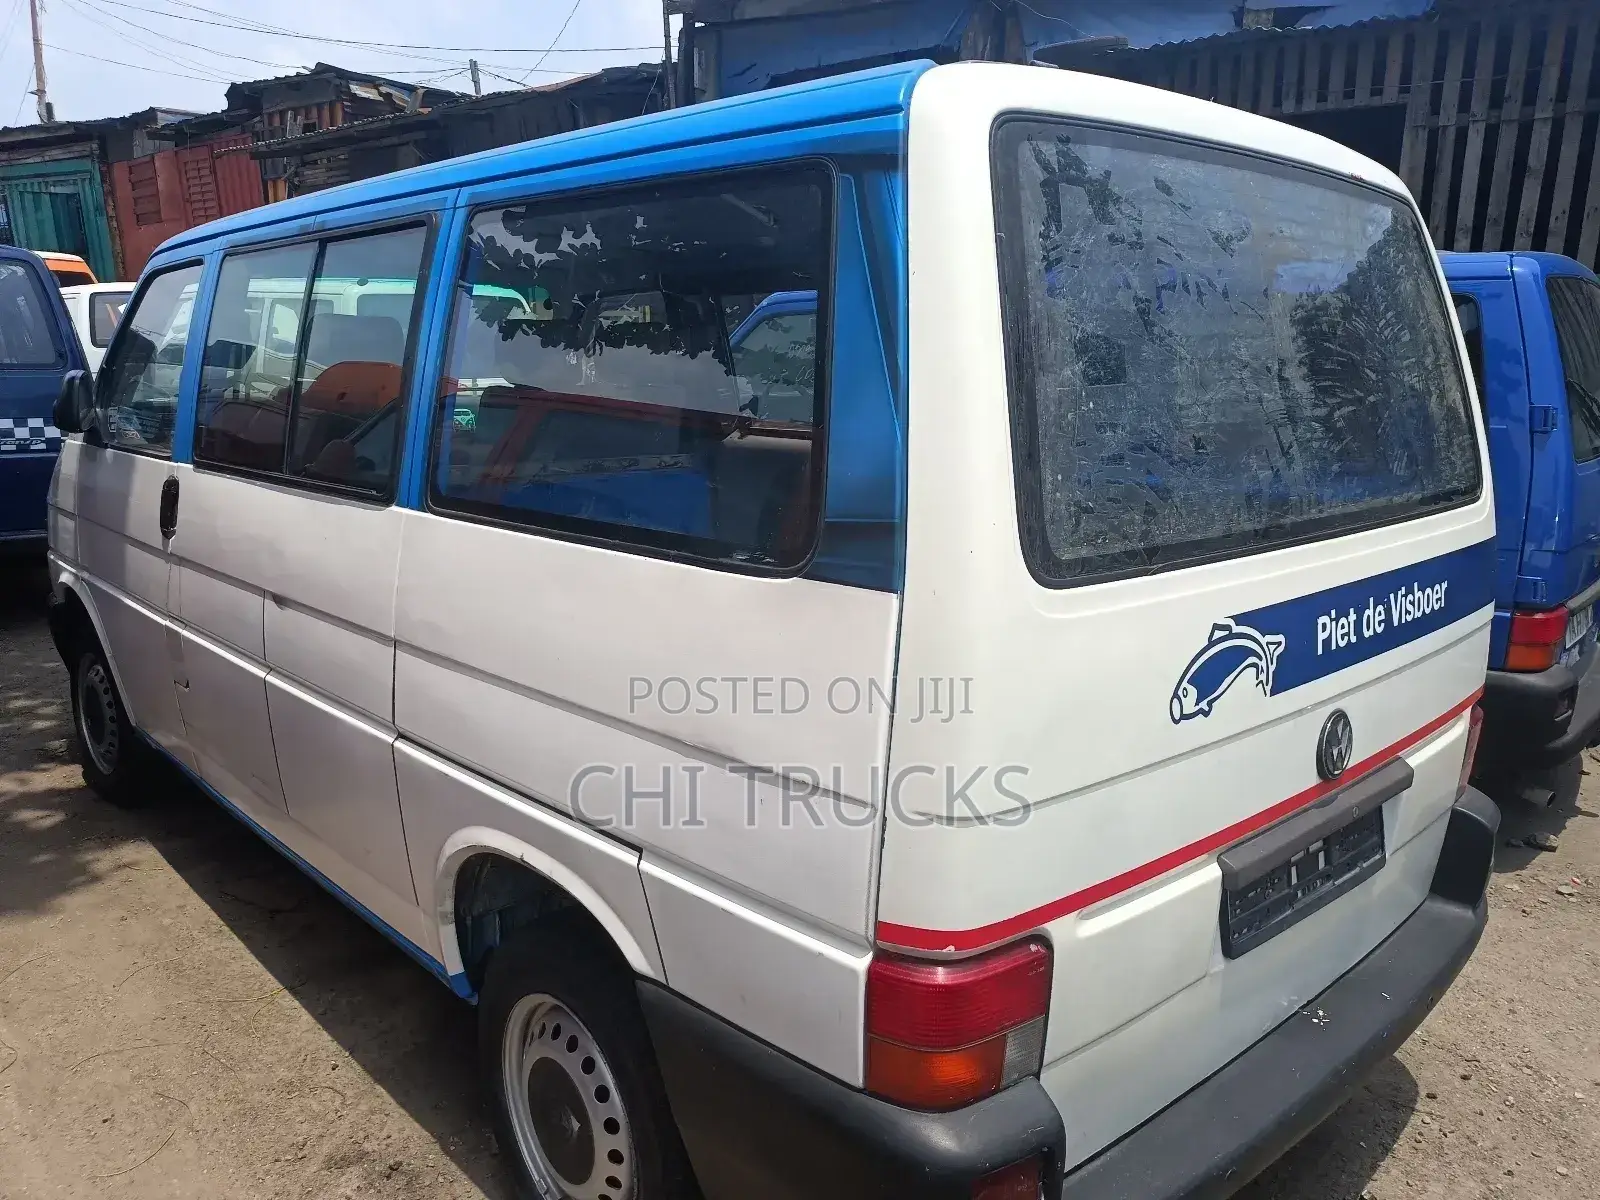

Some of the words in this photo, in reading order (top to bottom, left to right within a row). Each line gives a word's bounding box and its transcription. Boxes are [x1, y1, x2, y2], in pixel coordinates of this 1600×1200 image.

[1317, 608, 1357, 655] Piet
[1362, 597, 1386, 638] de
[1389, 580, 1448, 627] Visboer
